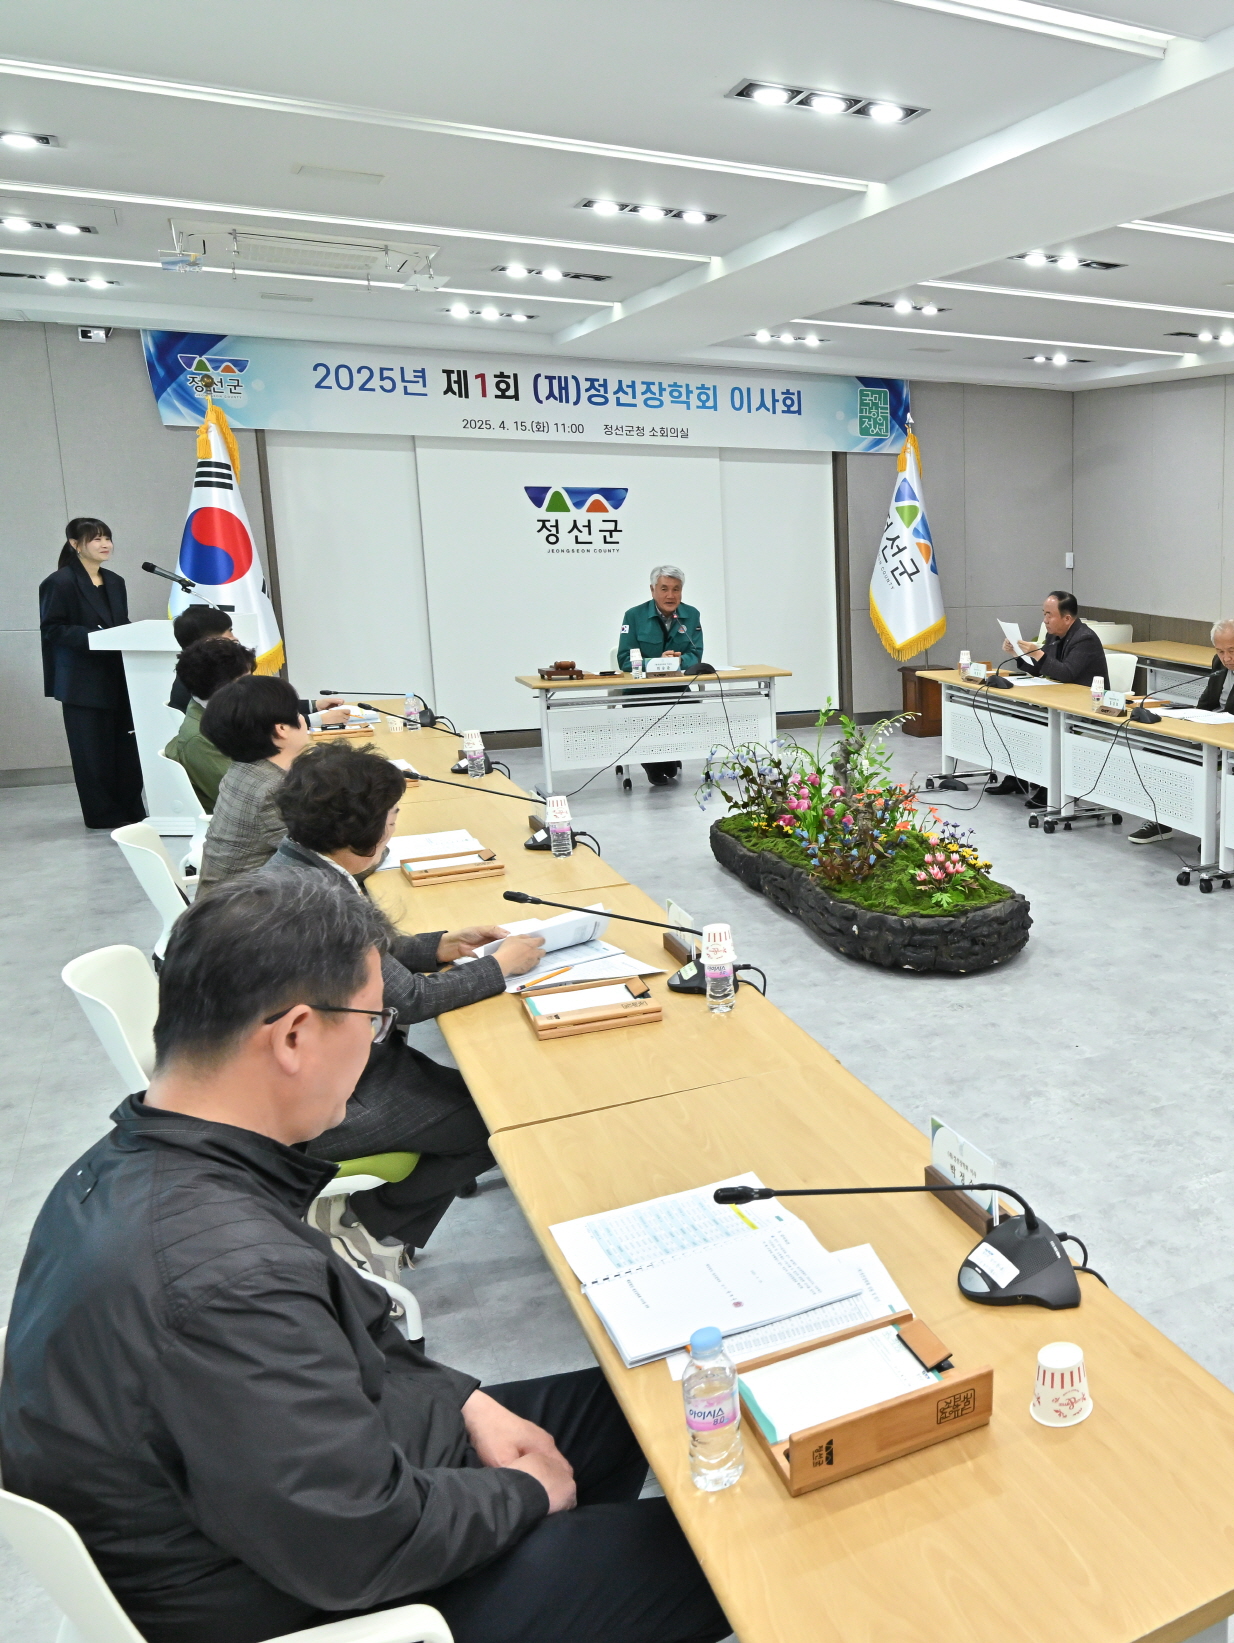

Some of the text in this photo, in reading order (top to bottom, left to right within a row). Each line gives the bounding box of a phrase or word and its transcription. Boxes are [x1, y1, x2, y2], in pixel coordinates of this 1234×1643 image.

[312, 362, 803, 416] 2025년 제1회 (재)정선장학회 이사회
[861, 391, 889, 407] 국민
[461, 418, 689, 439] 2025. 4. 15.(화) 11:00 정선군청 소회의실
[861, 418, 889, 435] 정선
[536, 518, 623, 545] 정선군
[882, 512, 920, 587] 선군
[689, 1407, 725, 1420] 아이시스
[713, 1416, 725, 1426] 8.0
